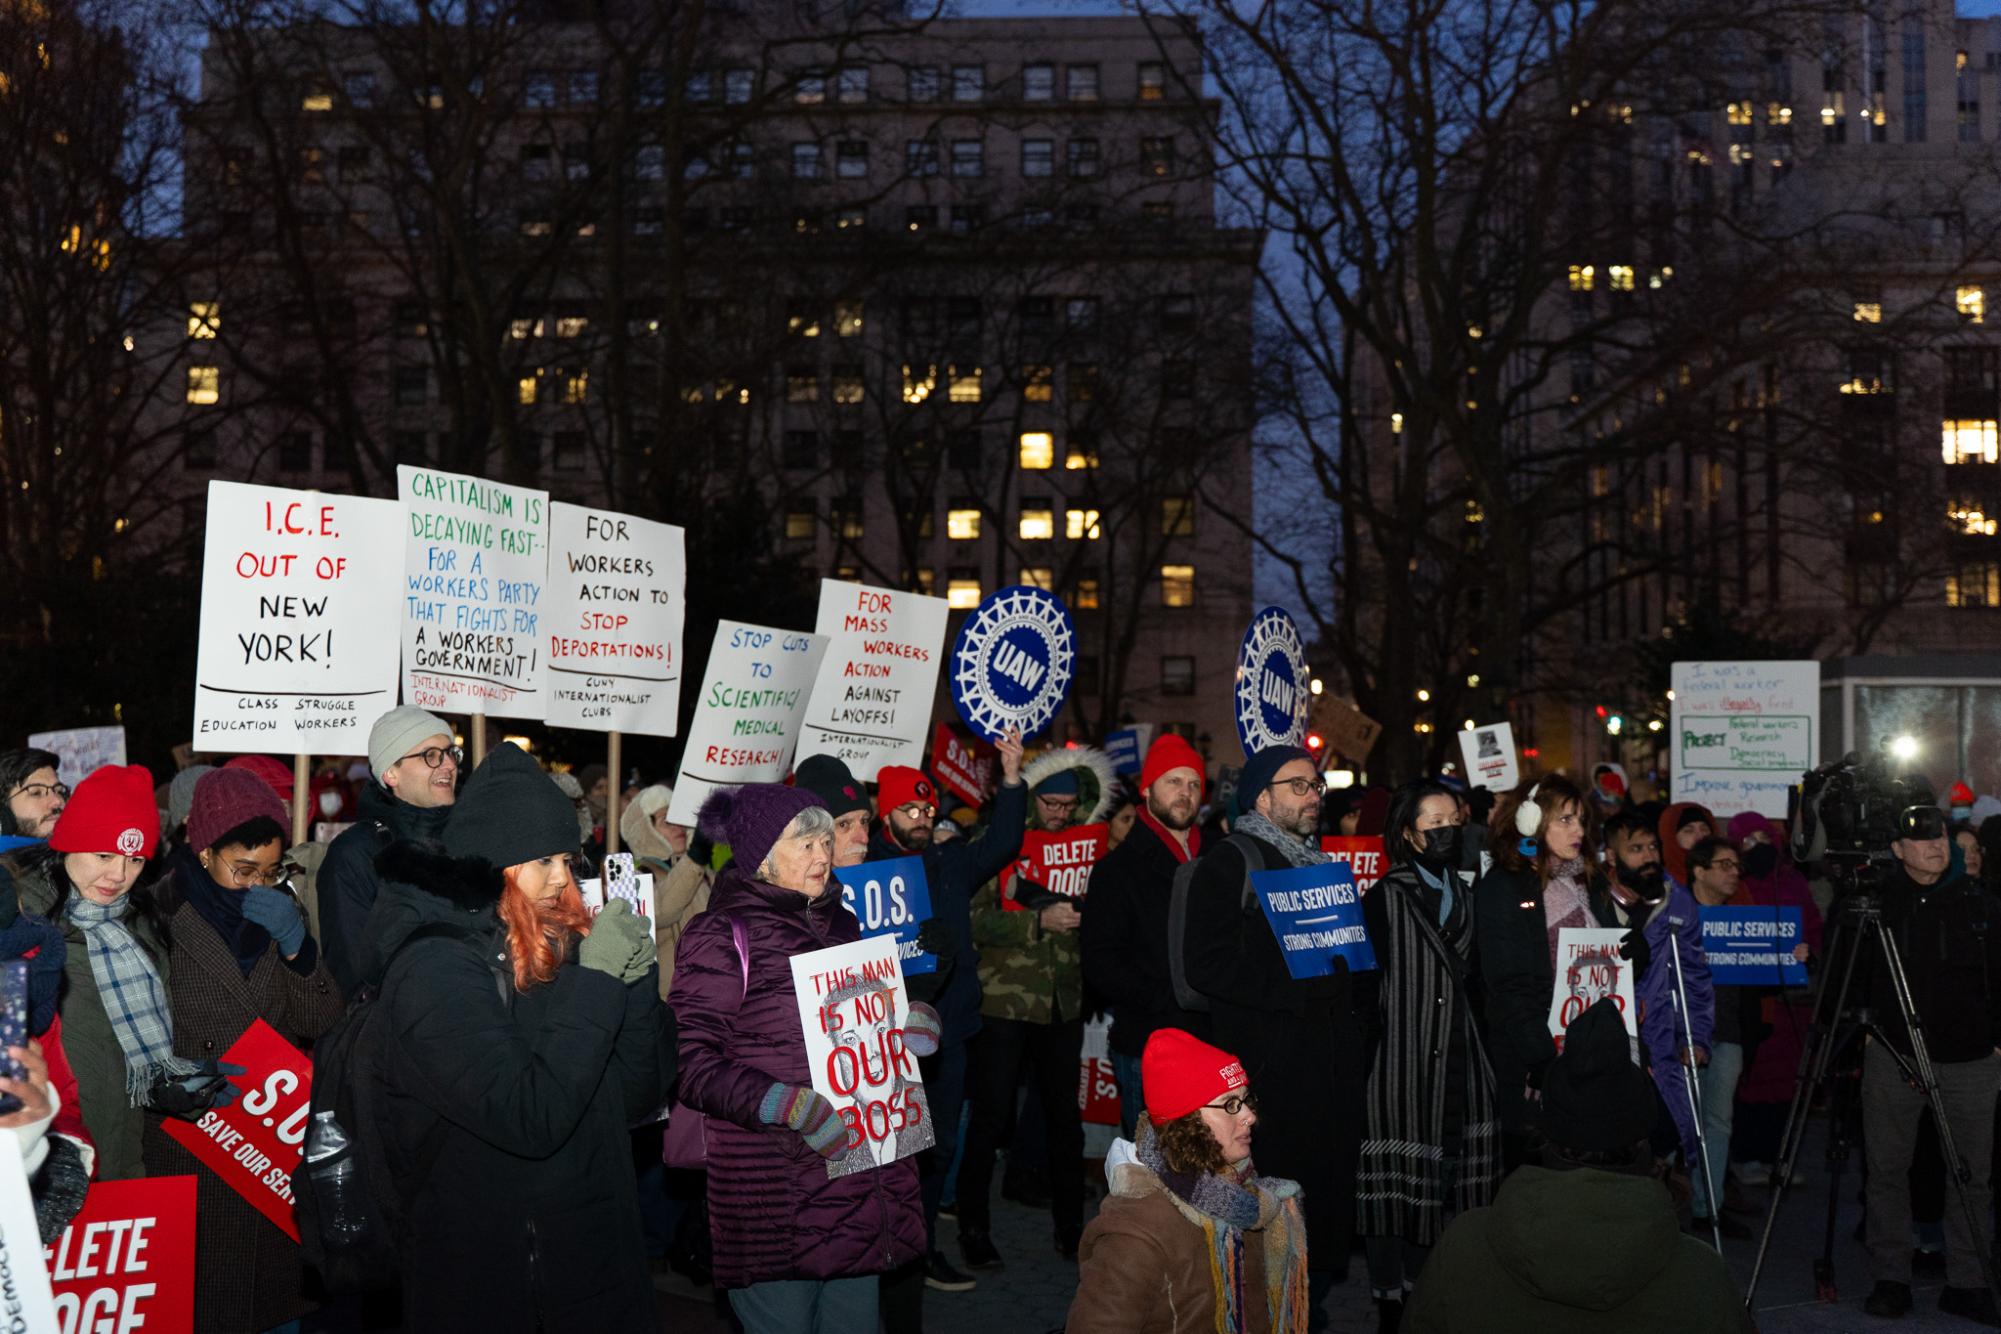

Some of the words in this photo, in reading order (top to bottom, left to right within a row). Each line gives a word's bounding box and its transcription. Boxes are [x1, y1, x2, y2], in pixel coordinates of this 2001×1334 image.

[412, 473, 513, 518] CAPITALISM
[524, 497, 542, 525] IS
[265, 501, 340, 538] I.C.E.
[411, 512, 494, 549] DECAYING
[586, 515, 630, 541] FOR
[235, 552, 298, 579] OUT
[316, 556, 347, 580] OF
[428, 547, 457, 572] FOR
[470, 552, 482, 575] A
[568, 551, 654, 577] WORKERS
[408, 575, 489, 601] WORKERS
[498, 579, 541, 606] PARTY
[579, 584, 639, 602] ACTION
[651, 590, 669, 605] TO
[858, 591, 892, 614] FOR
[260, 595, 328, 619] NEW
[407, 596, 447, 625] THAT
[456, 604, 508, 632] FIGHTS
[513, 609, 538, 637] FOR
[580, 611, 628, 631] STOP
[844, 615, 888, 633] MASS
[238, 629, 332, 670] YORK!
[415, 626, 426, 645] A
[438, 631, 515, 656] WORKERS
[551, 636, 672, 669] DEPORTATIONS!
[731, 628, 772, 649] STOP
[782, 634, 809, 651] CUTS
[864, 640, 929, 662] WORKERS
[415, 648, 536, 682] GOVERNMENT!
[752, 662, 772, 678] TO
[844, 660, 891, 678] ACTION
[993, 639, 1046, 692] UAW
[410, 674, 517, 702] INTERNATIONALIST
[586, 677, 616, 688] CUNY
[844, 685, 901, 704] AGAINST
[1262, 668, 1295, 716] UAW
[238, 698, 279, 710] CLASS
[295, 697, 355, 711] STRUGGLE
[414, 689, 447, 708] GROUP
[554, 690, 652, 705] INTERNATIONALIST
[200, 719, 277, 733] EDUCATION
[294, 716, 357, 730] WORKERS
[582, 707, 612, 718] CLUBS
[831, 708, 895, 728] LAYOFFS!
[733, 719, 785, 736] MEDICAL
[706, 745, 784, 772] RESEARCH!
[836, 748, 870, 760] GROUP
[1043, 839, 1097, 866] DELETE
[1267, 890, 1302, 912] PUBLIC
[1301, 882, 1355, 910] SERVICES
[1283, 933, 1314, 952] STRONG
[1311, 925, 1366, 949] COMMUNITIES
[1702, 920, 1742, 937] PUBLIC
[1568, 944, 1595, 960] THIS
[1738, 952, 1798, 966] COMMUNTIES
[809, 967, 856, 996] THIS
[862, 956, 896, 983] MAN
[1567, 965, 1582, 985] IS
[1589, 965, 1624, 987] NOT
[816, 1002, 844, 1035] IS
[854, 986, 900, 1026] NOT
[827, 1027, 913, 1097] OUR
[196, 1111, 244, 1152] SAVE
[233, 1142, 272, 1177] OUR
[262, 1167, 297, 1205] SER
